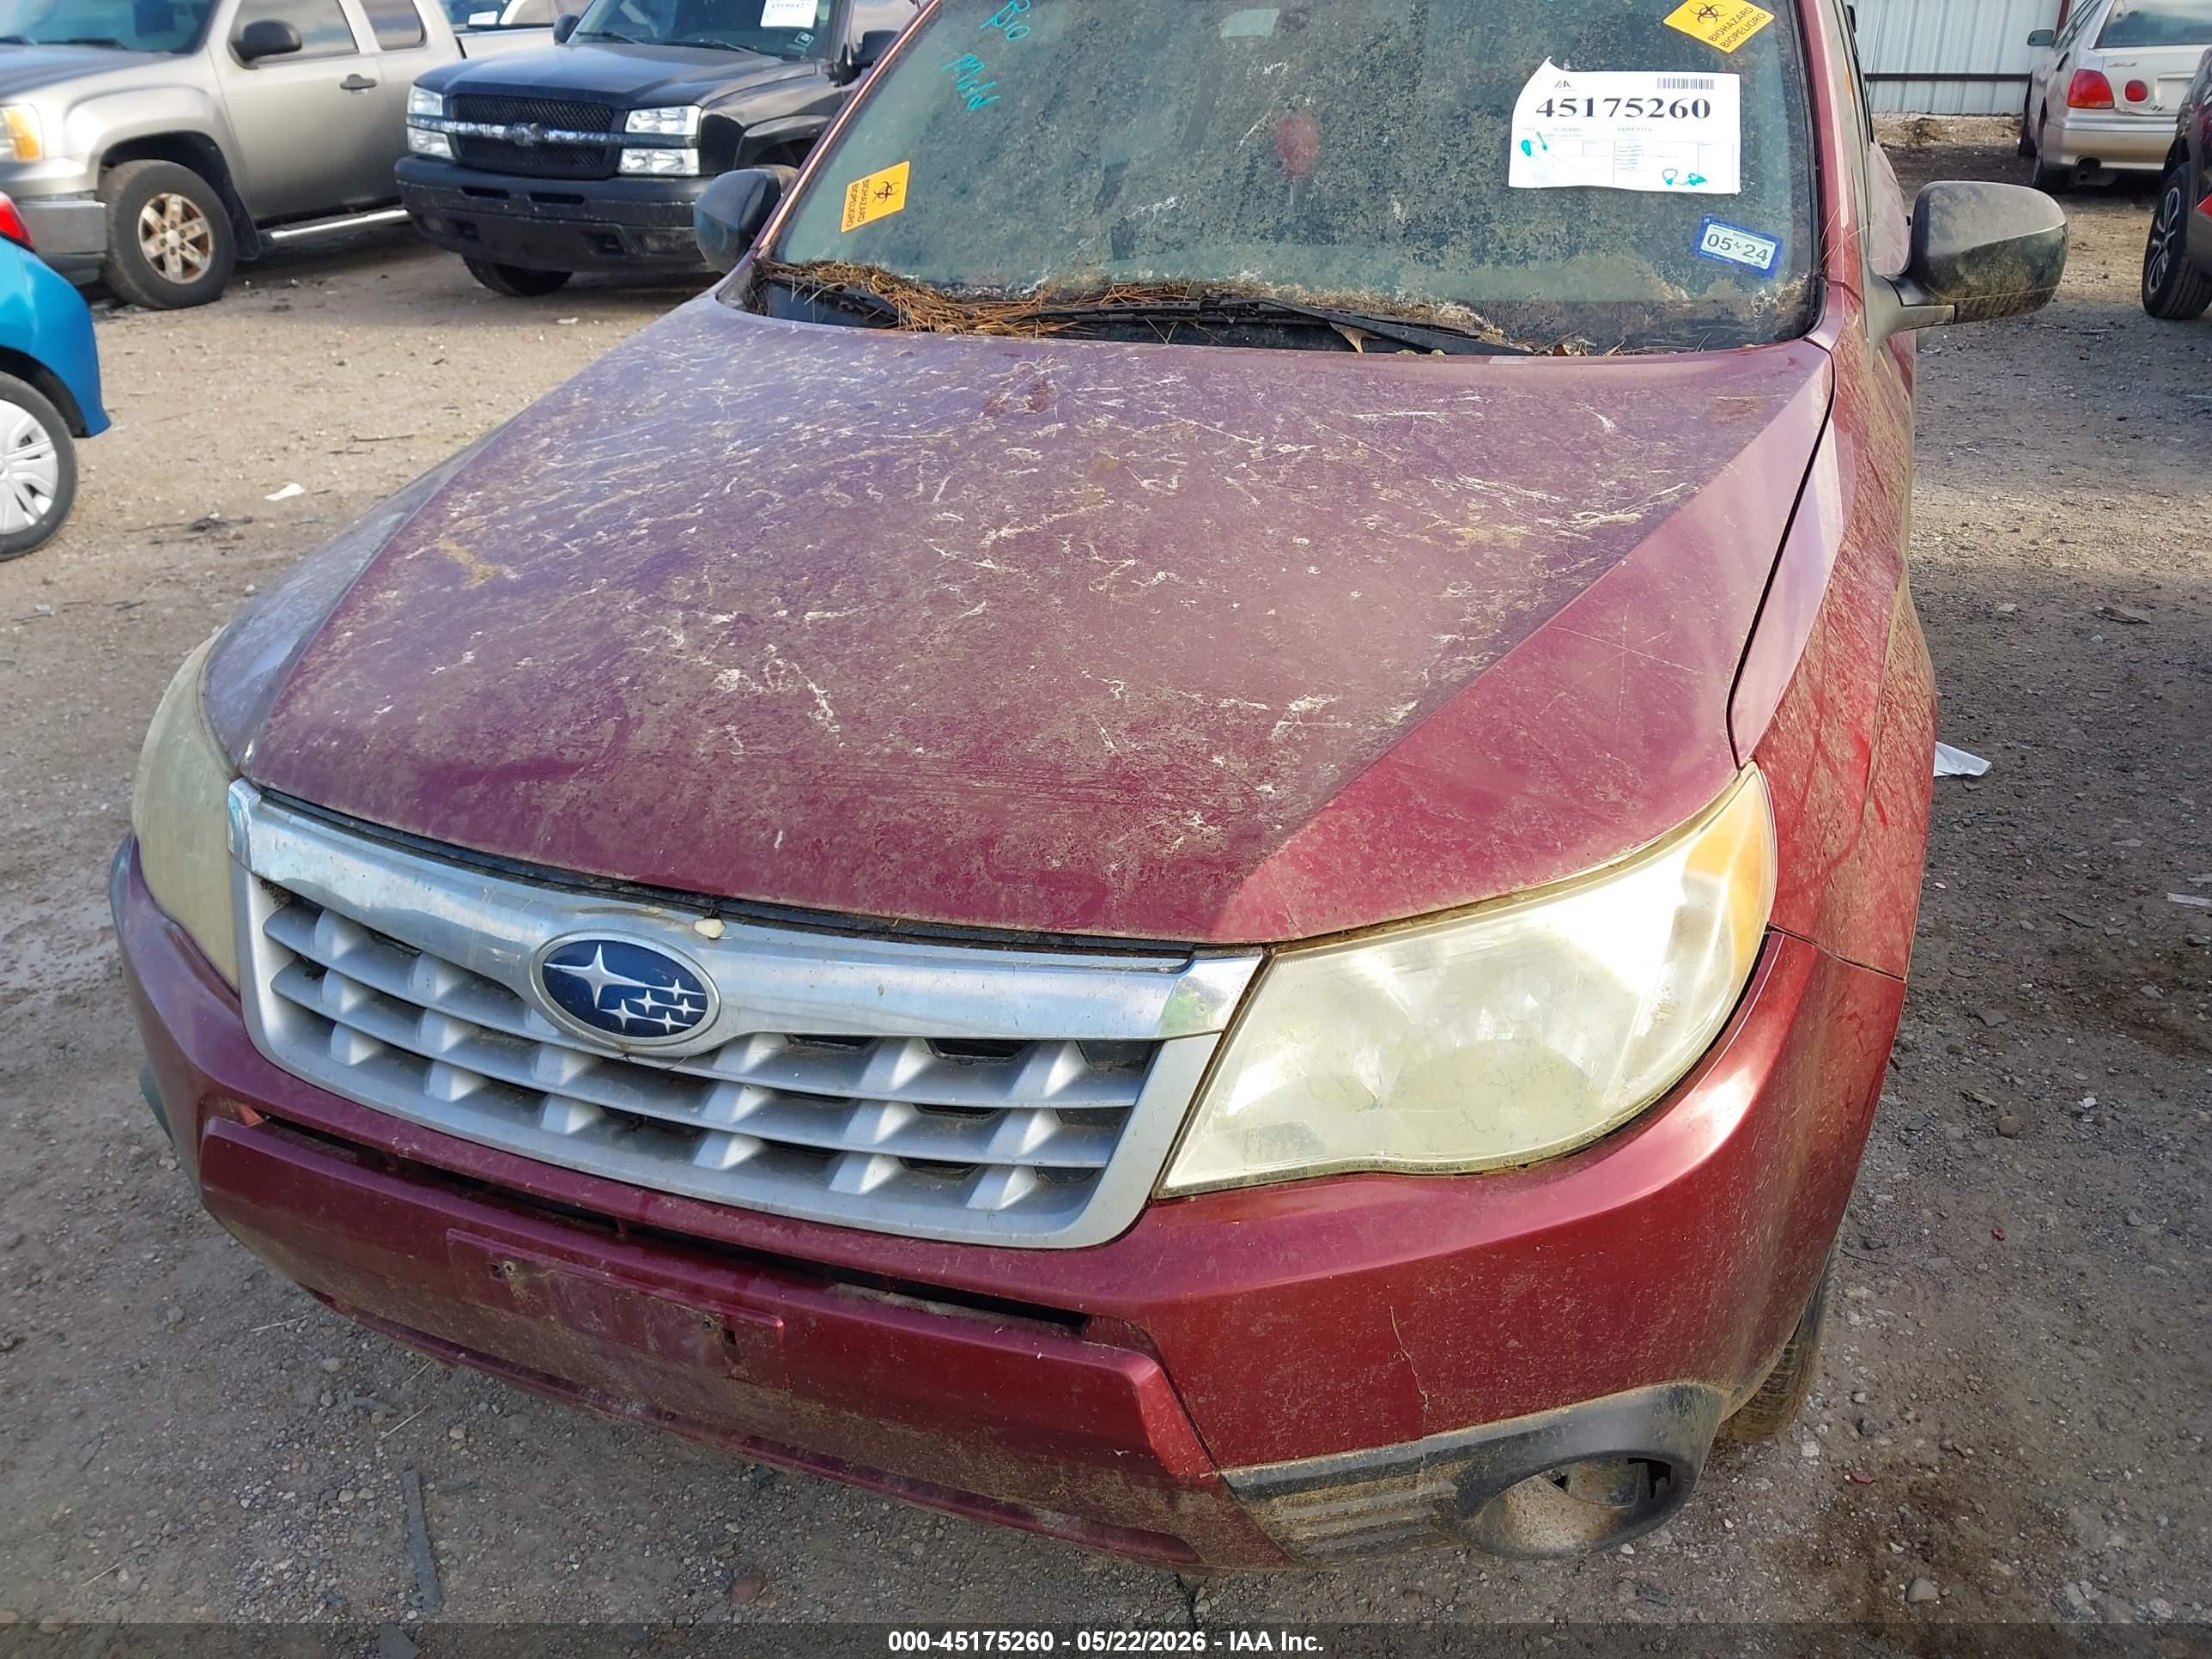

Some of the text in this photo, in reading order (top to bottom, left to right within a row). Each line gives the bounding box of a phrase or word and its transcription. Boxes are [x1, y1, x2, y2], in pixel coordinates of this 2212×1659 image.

[1708, 6, 1753, 42] BIOHAZARD
[1719, 12, 1766, 48] BIOPELIGRO
[1535, 97, 1711, 119] 45175260
[1707, 234, 1733, 251] 05
[1742, 244, 1768, 262] 24
